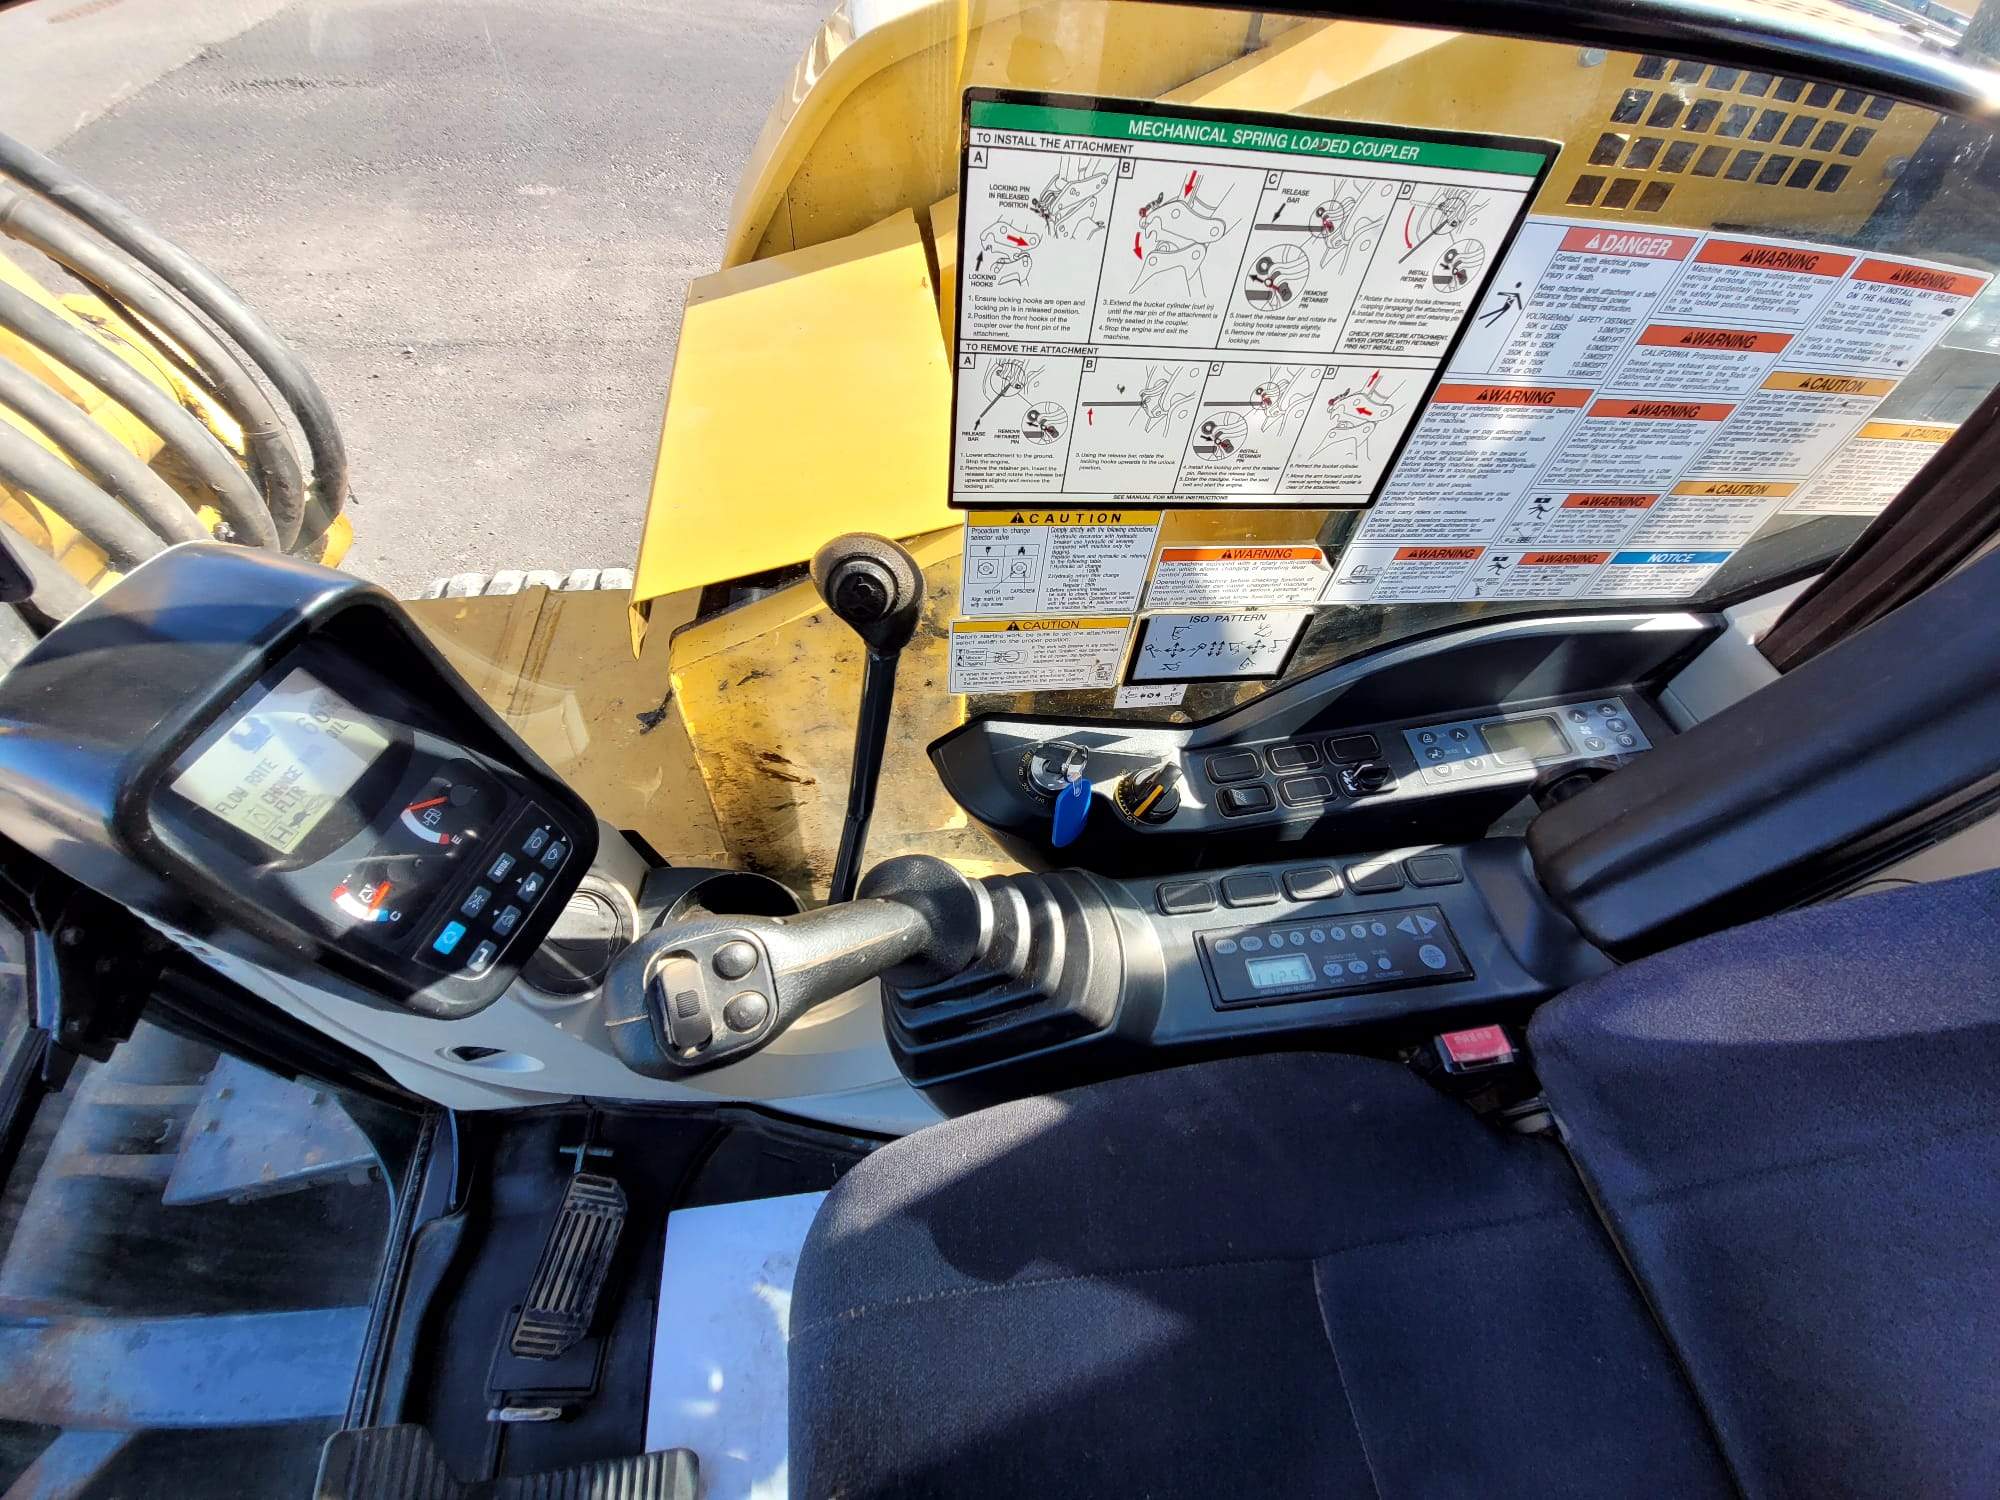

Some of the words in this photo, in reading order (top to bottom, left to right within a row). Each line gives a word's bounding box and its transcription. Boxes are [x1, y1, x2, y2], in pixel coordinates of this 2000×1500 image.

[976, 132, 991, 143] TO
[994, 133, 1036, 146] INSTALL
[1039, 137, 1061, 148] THE
[1063, 139, 1133, 153] ATTACHMENT
[1128, 120, 1228, 142] MECHANICAL
[1232, 130, 1287, 148] SPRING
[1291, 135, 1348, 154] LOADED
[1352, 140, 1420, 160] COUPLER
[973, 150, 982, 163] A
[1121, 161, 1130, 173] B
[1268, 172, 1278, 184] C
[989, 183, 1018, 192] LOCKING
[1281, 188, 1309, 196] RELEASE
[1401, 185, 1411, 195] D
[996, 192, 1029, 200] RELEASED
[998, 200, 1028, 208] POSITION
[1601, 234, 1672, 256] DANGER
[1751, 249, 1818, 270] WARNING
[1896, 271, 1955, 290] WARNING
[1860, 292, 1877, 302] THE
[1876, 295, 1912, 306] HANDRAIL
[1692, 331, 1757, 348] WARNING
[980, 343, 1018, 352] REMOVE
[1040, 345, 1098, 354] ATTACHMENT
[963, 356, 971, 365] A
[1085, 359, 1093, 368] B
[1211, 363, 1220, 372] C
[1326, 367, 1335, 375] D
[1809, 377, 1866, 392] CAUTION
[1488, 388, 1555, 404] WARNING
[1638, 404, 1700, 418] WARNING
[1715, 484, 1770, 494] CAUTION
[1588, 496, 1645, 506] WARNING
[1029, 512, 1121, 523] CAUTION
[1233, 548, 1292, 558] WARNING
[1417, 548, 1475, 559] WARNING
[1647, 553, 1696, 563] NOTICE
[1544, 554, 1598, 563] WARNING
[1188, 615, 1209, 623] ISO
[1213, 613, 1266, 623] PATTERN
[1022, 620, 1079, 630] CAUTION
[216, 784, 248, 816] FLOW
[244, 758, 279, 788] RATE
[452, 835, 462, 844] E
[494, 860, 510, 877] MODE
